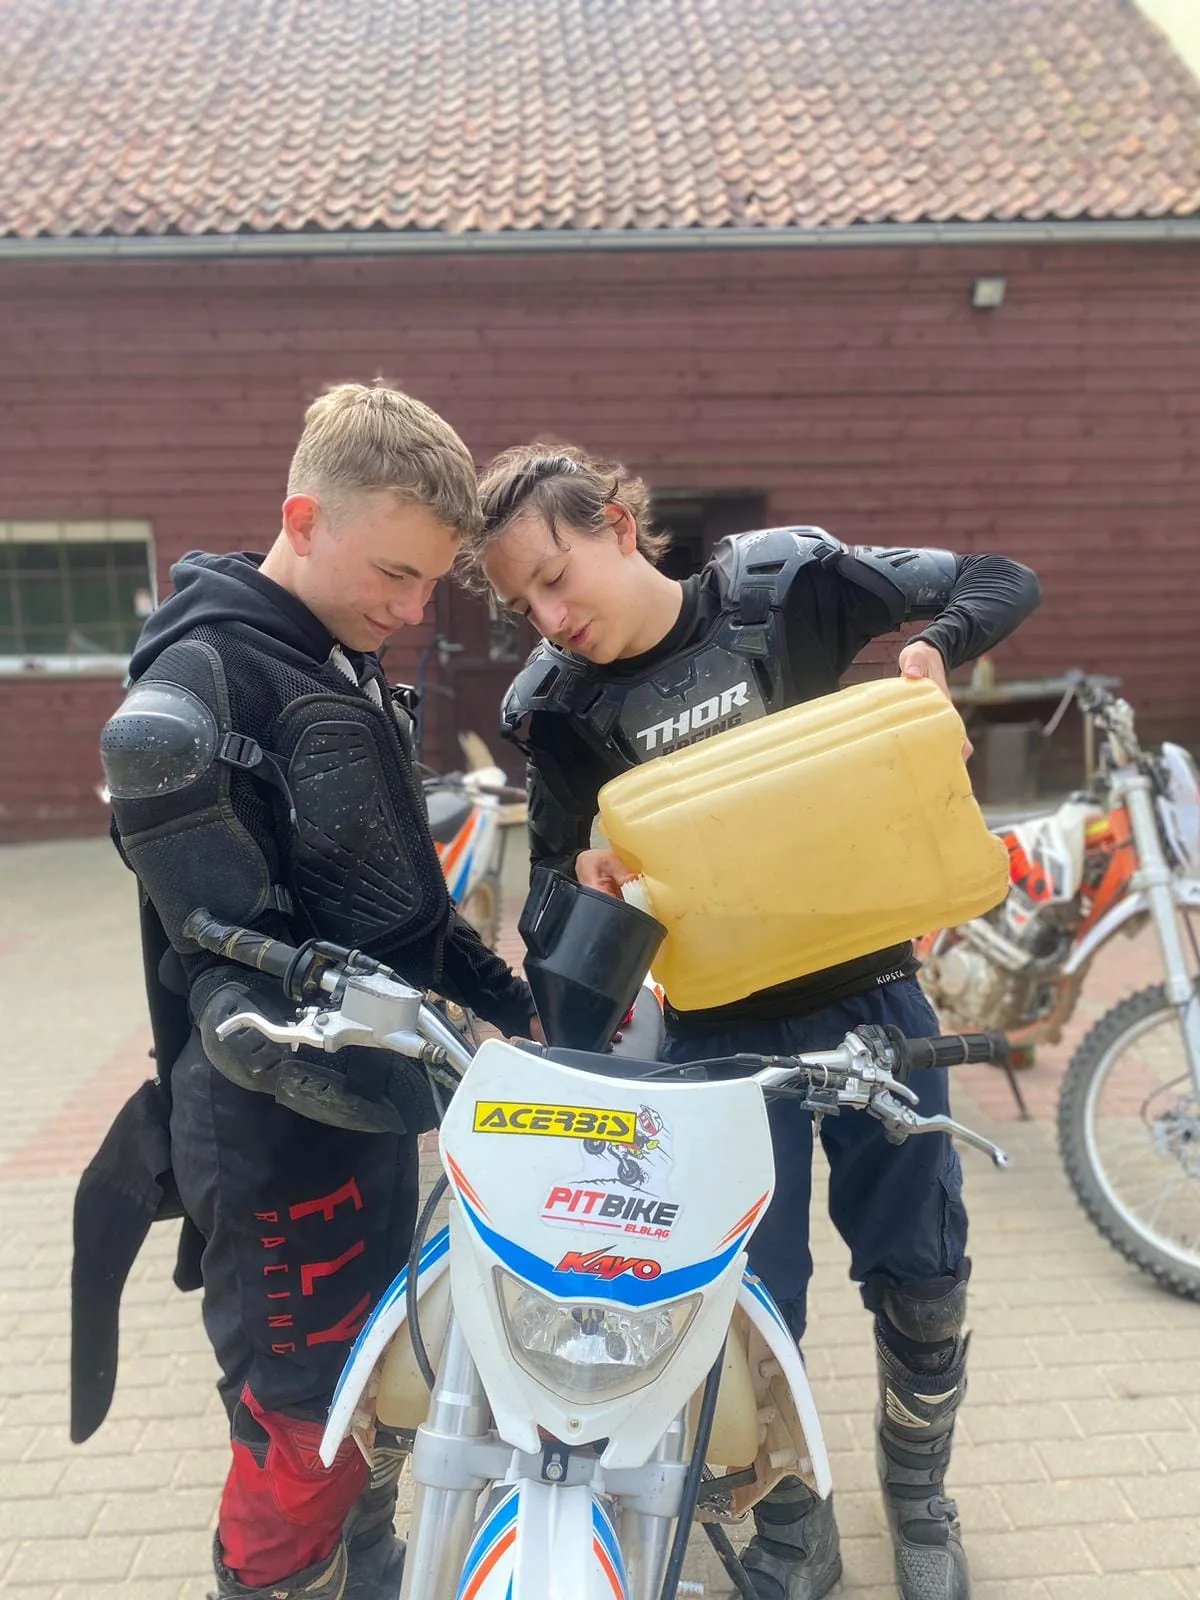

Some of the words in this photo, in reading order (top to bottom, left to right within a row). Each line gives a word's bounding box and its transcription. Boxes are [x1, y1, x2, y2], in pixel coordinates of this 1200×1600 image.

[637, 681, 750, 751] THOR
[875, 970, 906, 985] KIPSTA
[254, 1211, 296, 1354] RACING
[288, 1176, 371, 1347] FLY
[553, 1243, 662, 1281] KAYO
